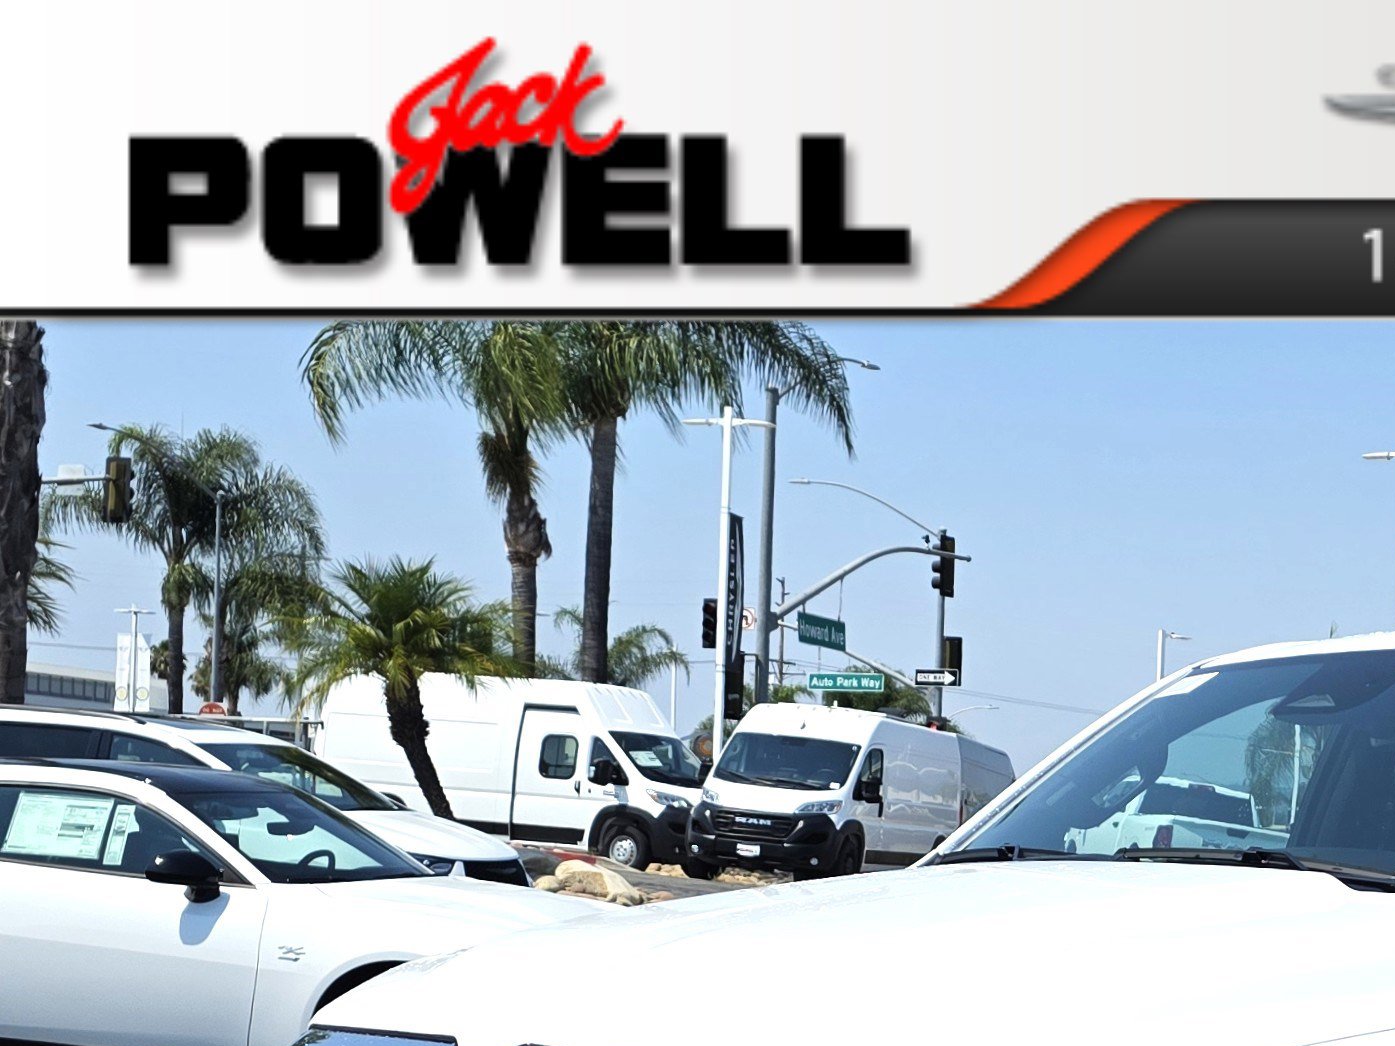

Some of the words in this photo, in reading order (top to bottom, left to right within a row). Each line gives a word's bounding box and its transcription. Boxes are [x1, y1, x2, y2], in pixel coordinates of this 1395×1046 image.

[799, 618, 830, 642] Howard
[831, 626, 845, 646] Ave
[810, 676, 834, 687] Auto
[836, 676, 858, 687] Park
[860, 677, 881, 689] Way
[734, 816, 772, 826] RAM
